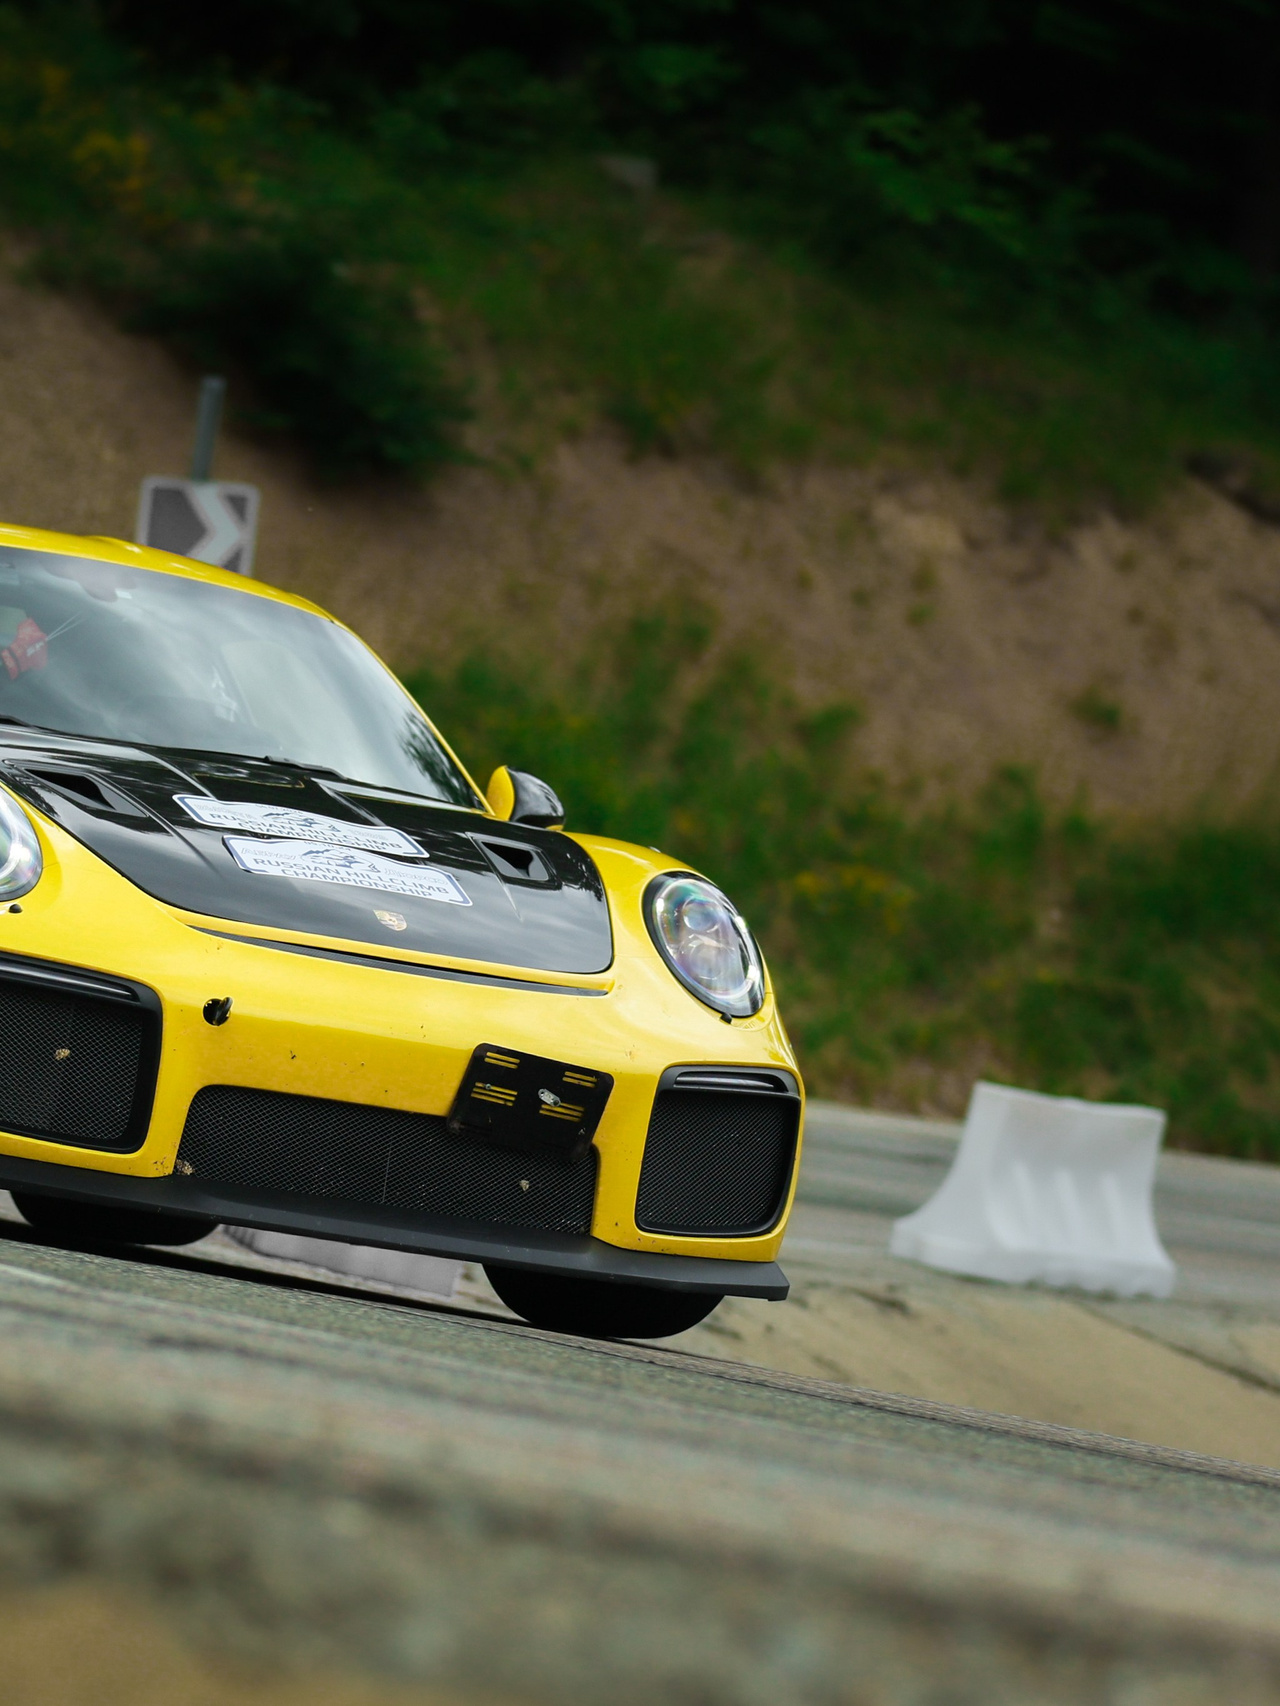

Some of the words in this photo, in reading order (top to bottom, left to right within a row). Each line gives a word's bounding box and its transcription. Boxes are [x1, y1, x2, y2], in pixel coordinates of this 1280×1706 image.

[209, 813, 295, 831] RUSSIAN
[299, 828, 403, 849] HILLCLIMB
[238, 822, 387, 850] CHAMPIONSHIP
[253, 858, 341, 875] RUSSIAN
[346, 870, 449, 894] HILLCLIMB
[281, 869, 432, 896] CHAMPIONSHIP
